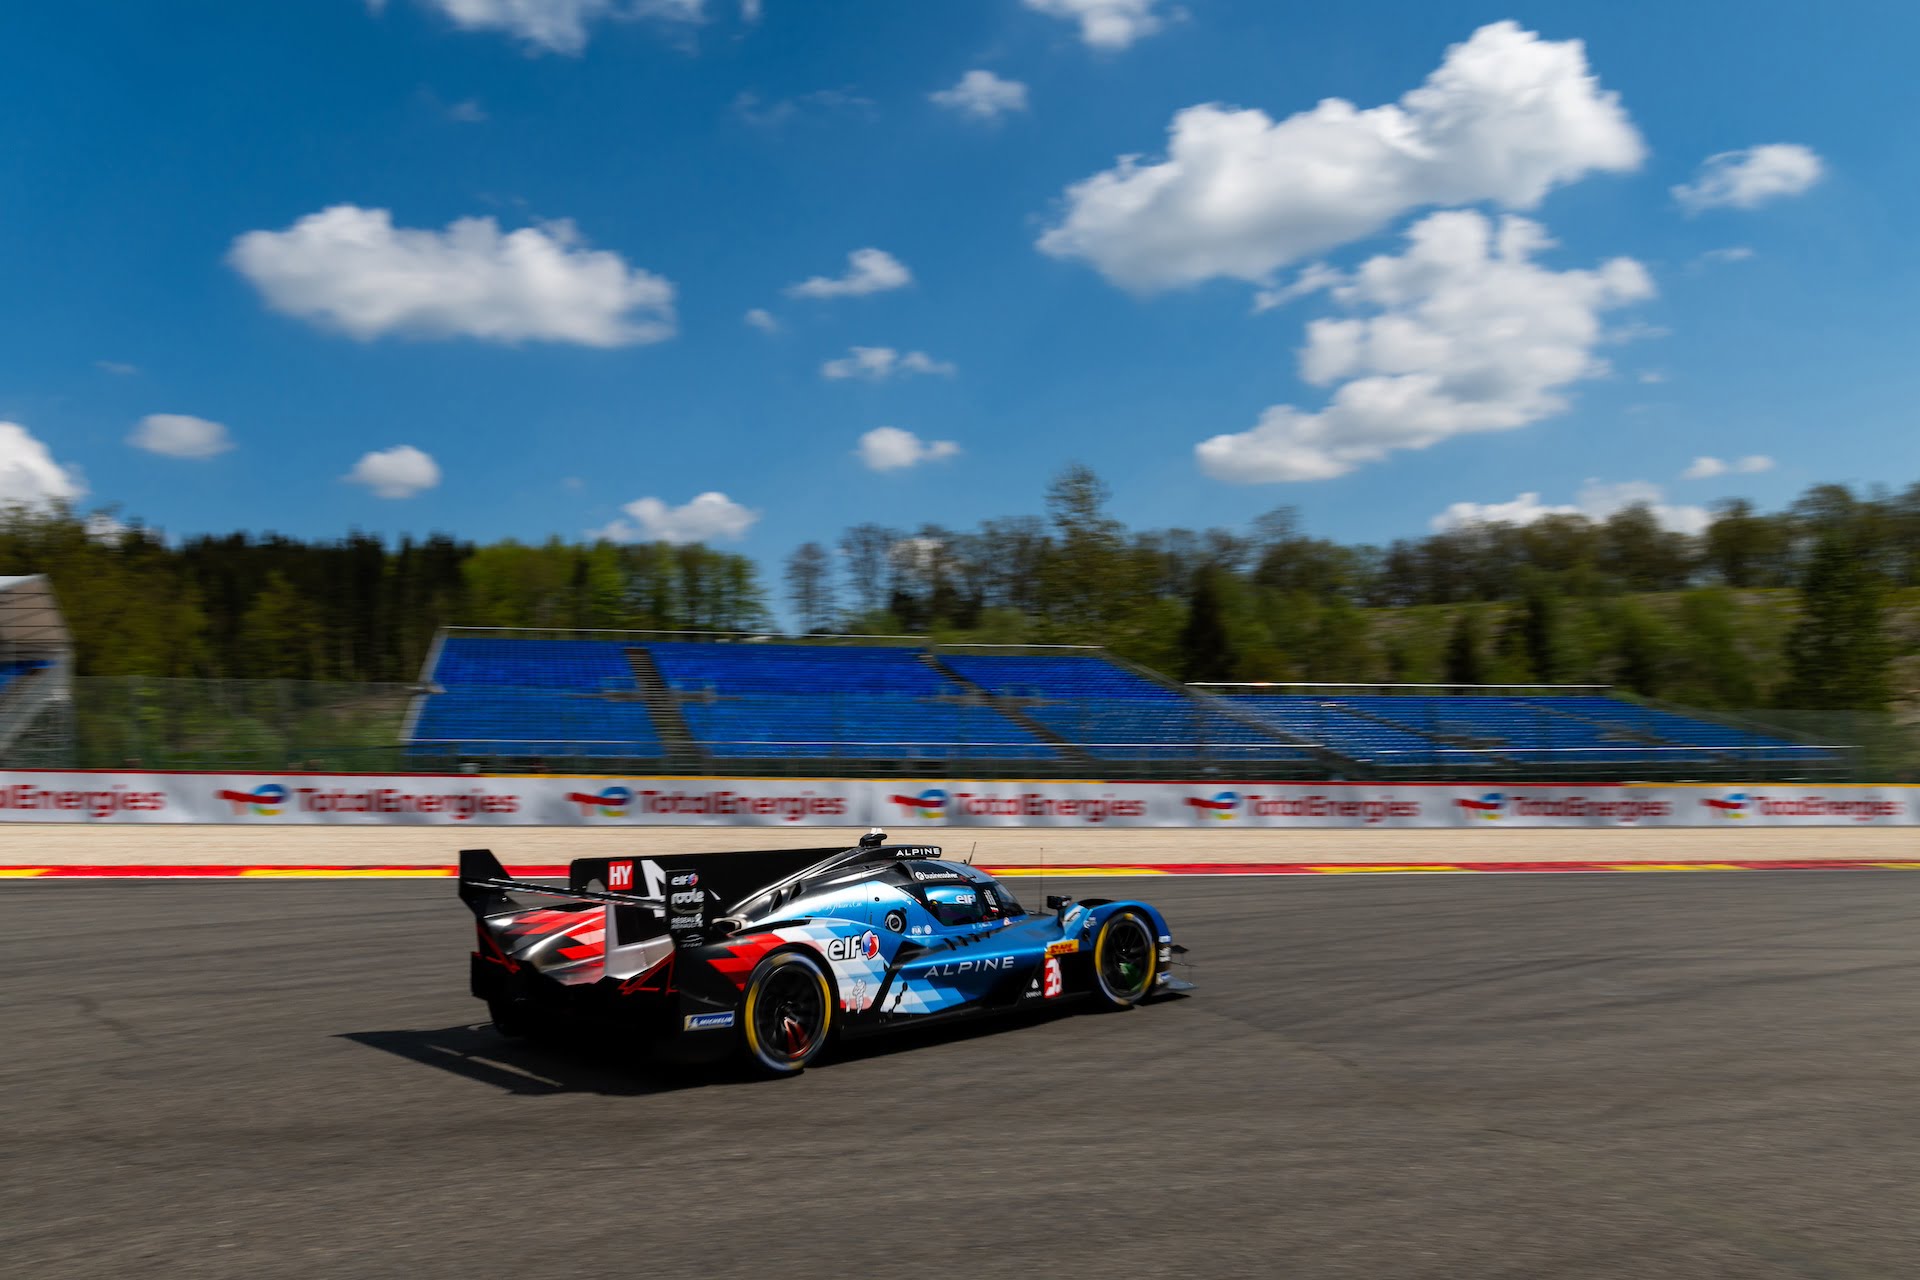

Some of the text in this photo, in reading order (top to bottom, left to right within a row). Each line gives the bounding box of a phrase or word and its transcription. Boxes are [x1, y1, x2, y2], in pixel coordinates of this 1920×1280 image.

[296, 788, 522, 820] TotalEnergies
[638, 791, 849, 822] TotalEnergies
[955, 793, 1149, 822] TotalEnergies
[1243, 795, 1422, 823] TotalEnergies
[1509, 796, 1673, 823] TotalEnergies
[1751, 796, 1906, 822] TotalEnergies
[896, 847, 940, 857] ALPINE
[609, 865, 632, 886] HY
[955, 894, 975, 905] elf
[828, 936, 862, 961] elf
[924, 956, 1015, 978] ALPINE
[699, 1016, 733, 1026] MICHELIN
